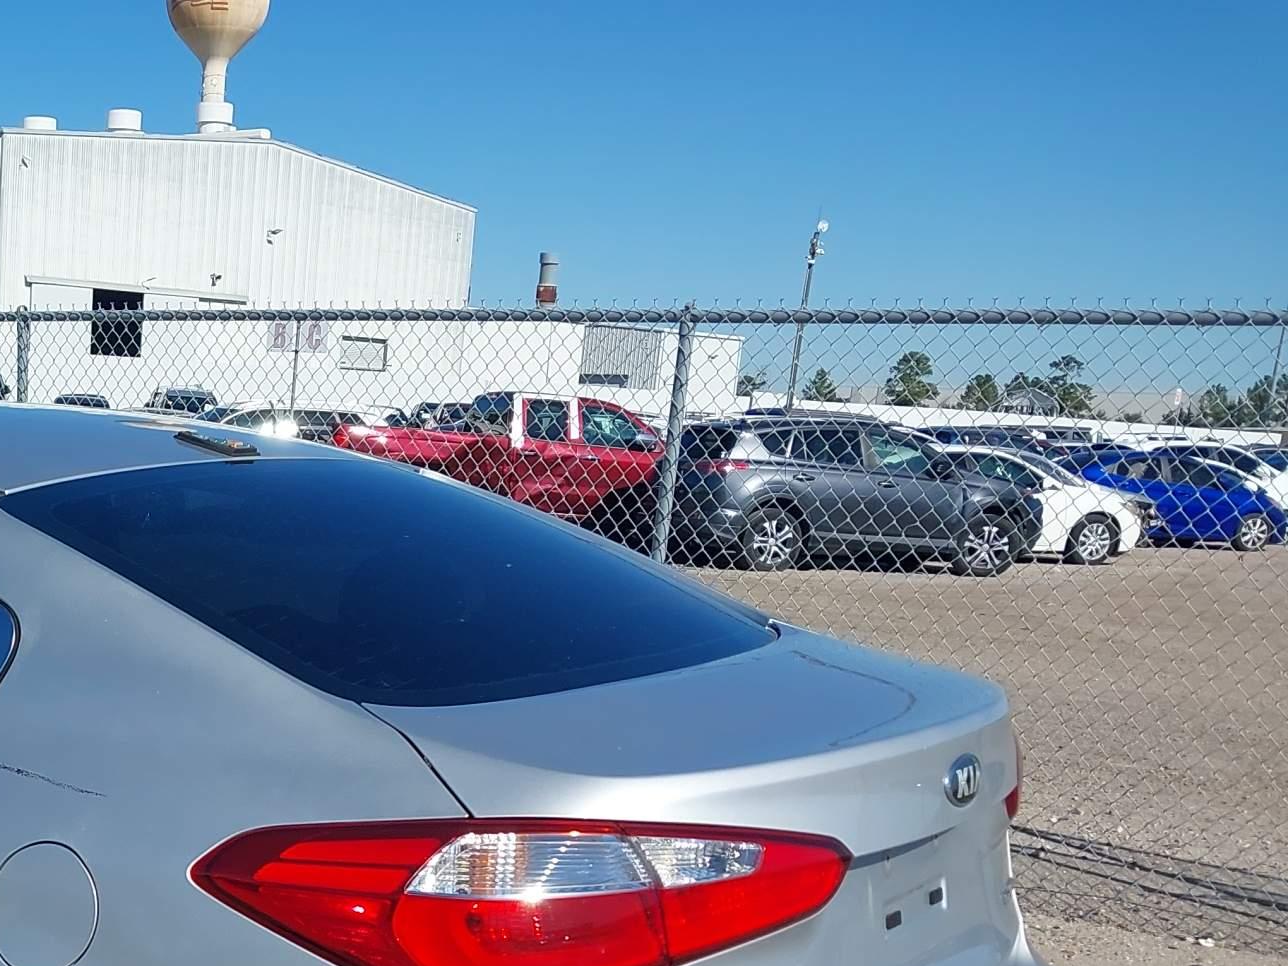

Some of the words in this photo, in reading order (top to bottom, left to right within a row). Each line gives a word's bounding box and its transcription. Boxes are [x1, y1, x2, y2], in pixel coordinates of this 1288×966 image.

[273, 322, 286, 349] B
[308, 322, 323, 350] C
[955, 763, 981, 799] KIA
